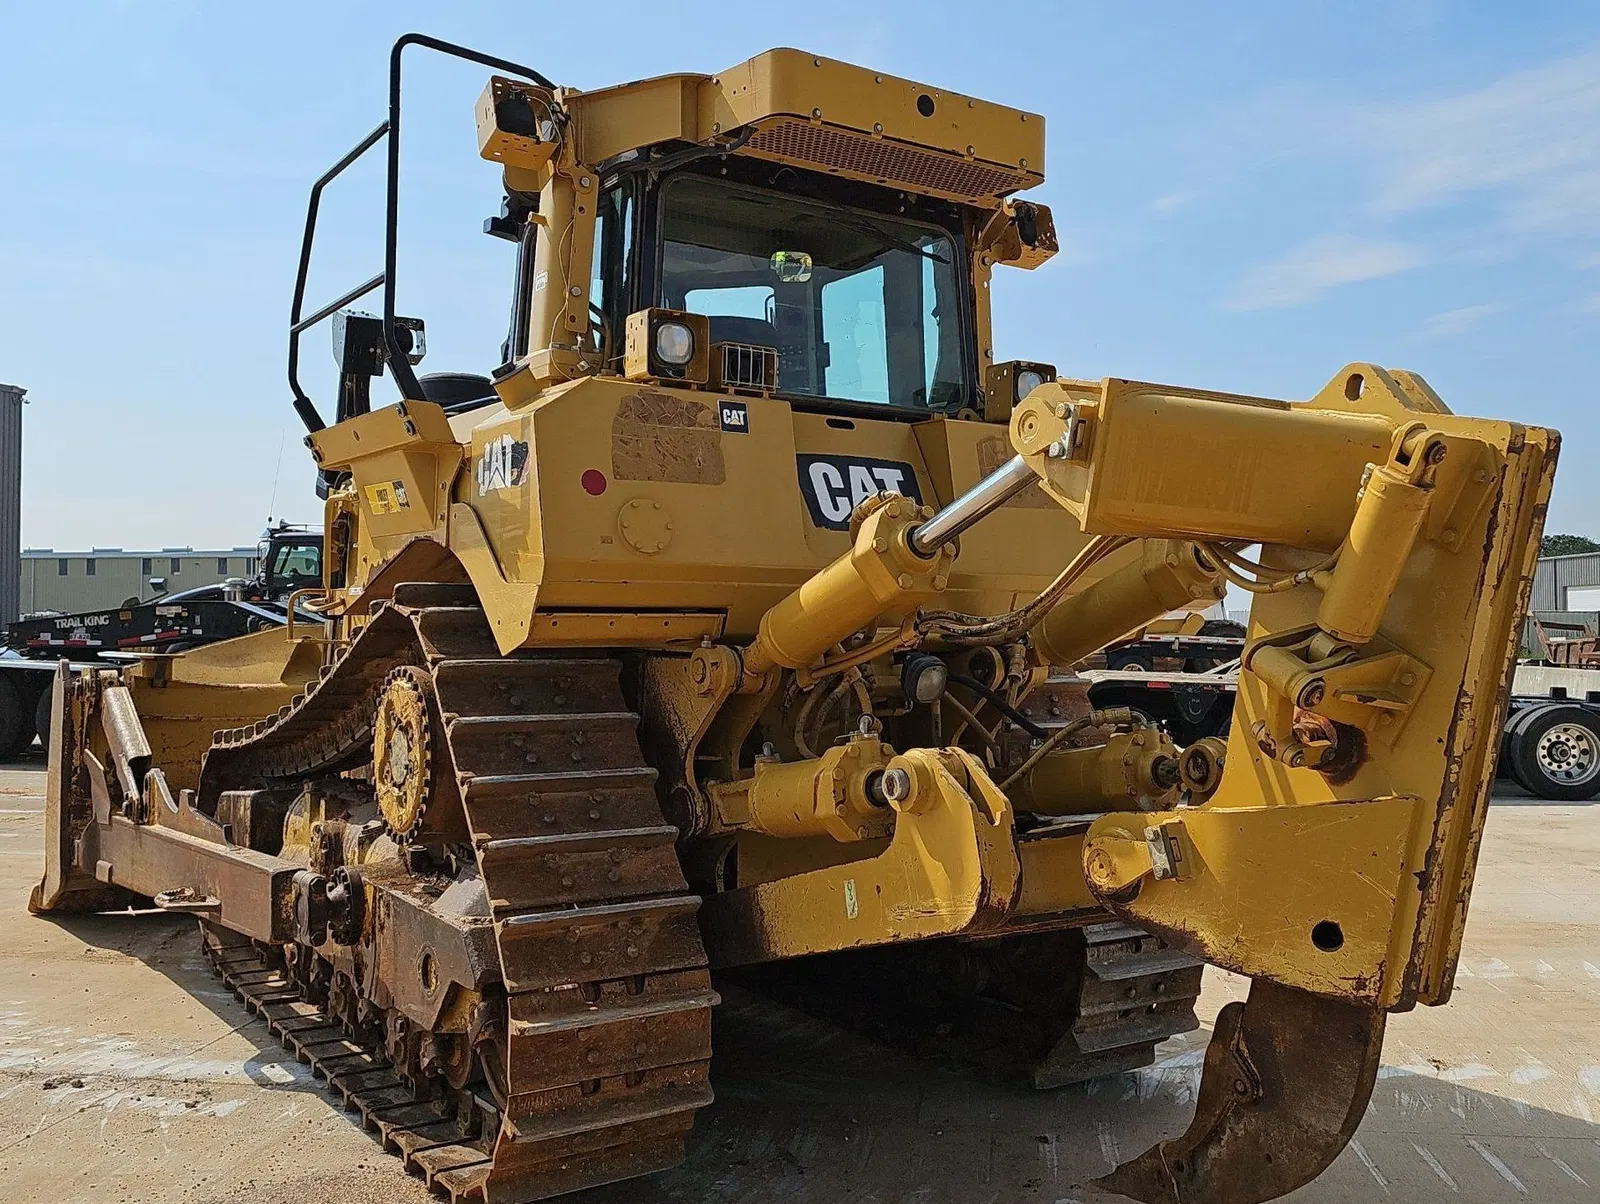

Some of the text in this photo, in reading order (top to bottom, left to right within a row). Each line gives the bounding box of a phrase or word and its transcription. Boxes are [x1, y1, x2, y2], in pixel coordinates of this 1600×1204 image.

[722, 409, 746, 426] CAT
[478, 433, 515, 497] CAT
[808, 461, 904, 523] CAT
